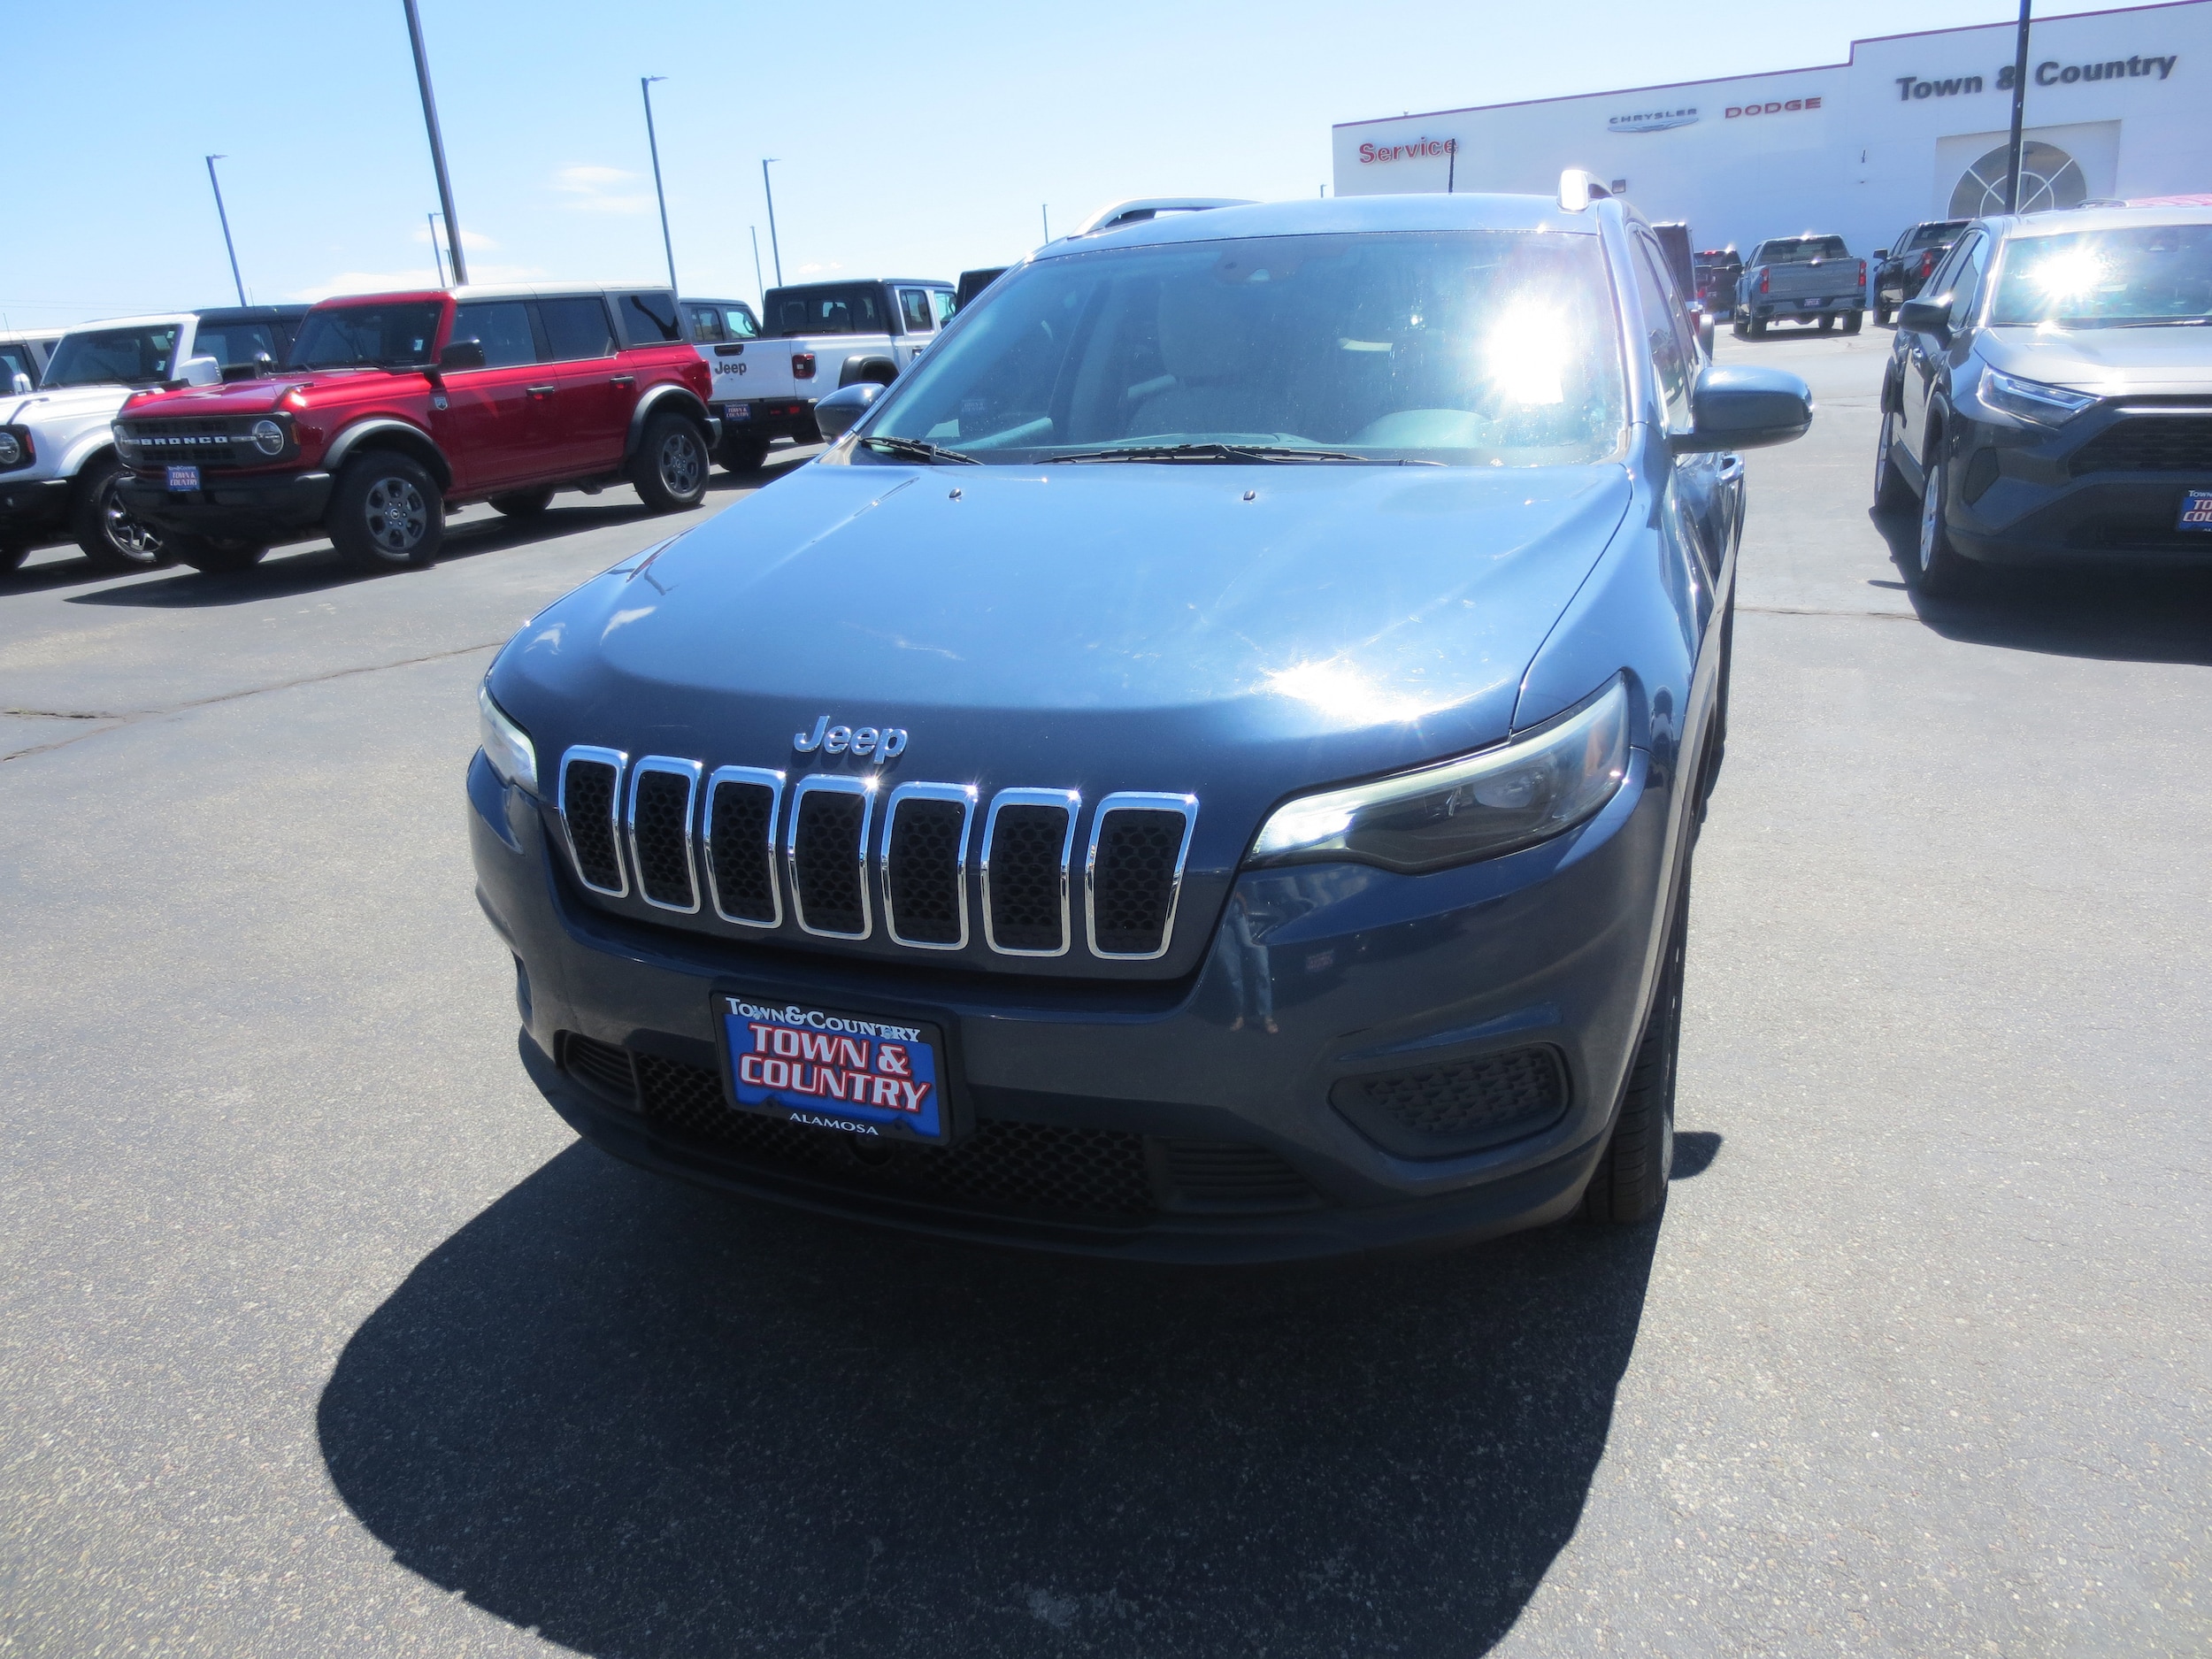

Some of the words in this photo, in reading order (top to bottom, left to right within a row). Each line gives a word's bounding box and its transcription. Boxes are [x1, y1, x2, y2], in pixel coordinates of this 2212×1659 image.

[1896, 75, 1983, 102] Town
[2035, 54, 2177, 87] Country
[1609, 107, 1698, 125] CHRYSLER
[1724, 96, 1822, 119] DODGE
[1358, 136, 1458, 165] Service
[715, 361, 747, 376] Jeep
[141, 436, 227, 445] BRONCO
[794, 715, 908, 764] Jeep
[749, 1023, 870, 1071] TOWN
[878, 1043, 912, 1077] &
[739, 1054, 931, 1113] COUNTRY
[789, 1112, 879, 1135] ALAMOSA
